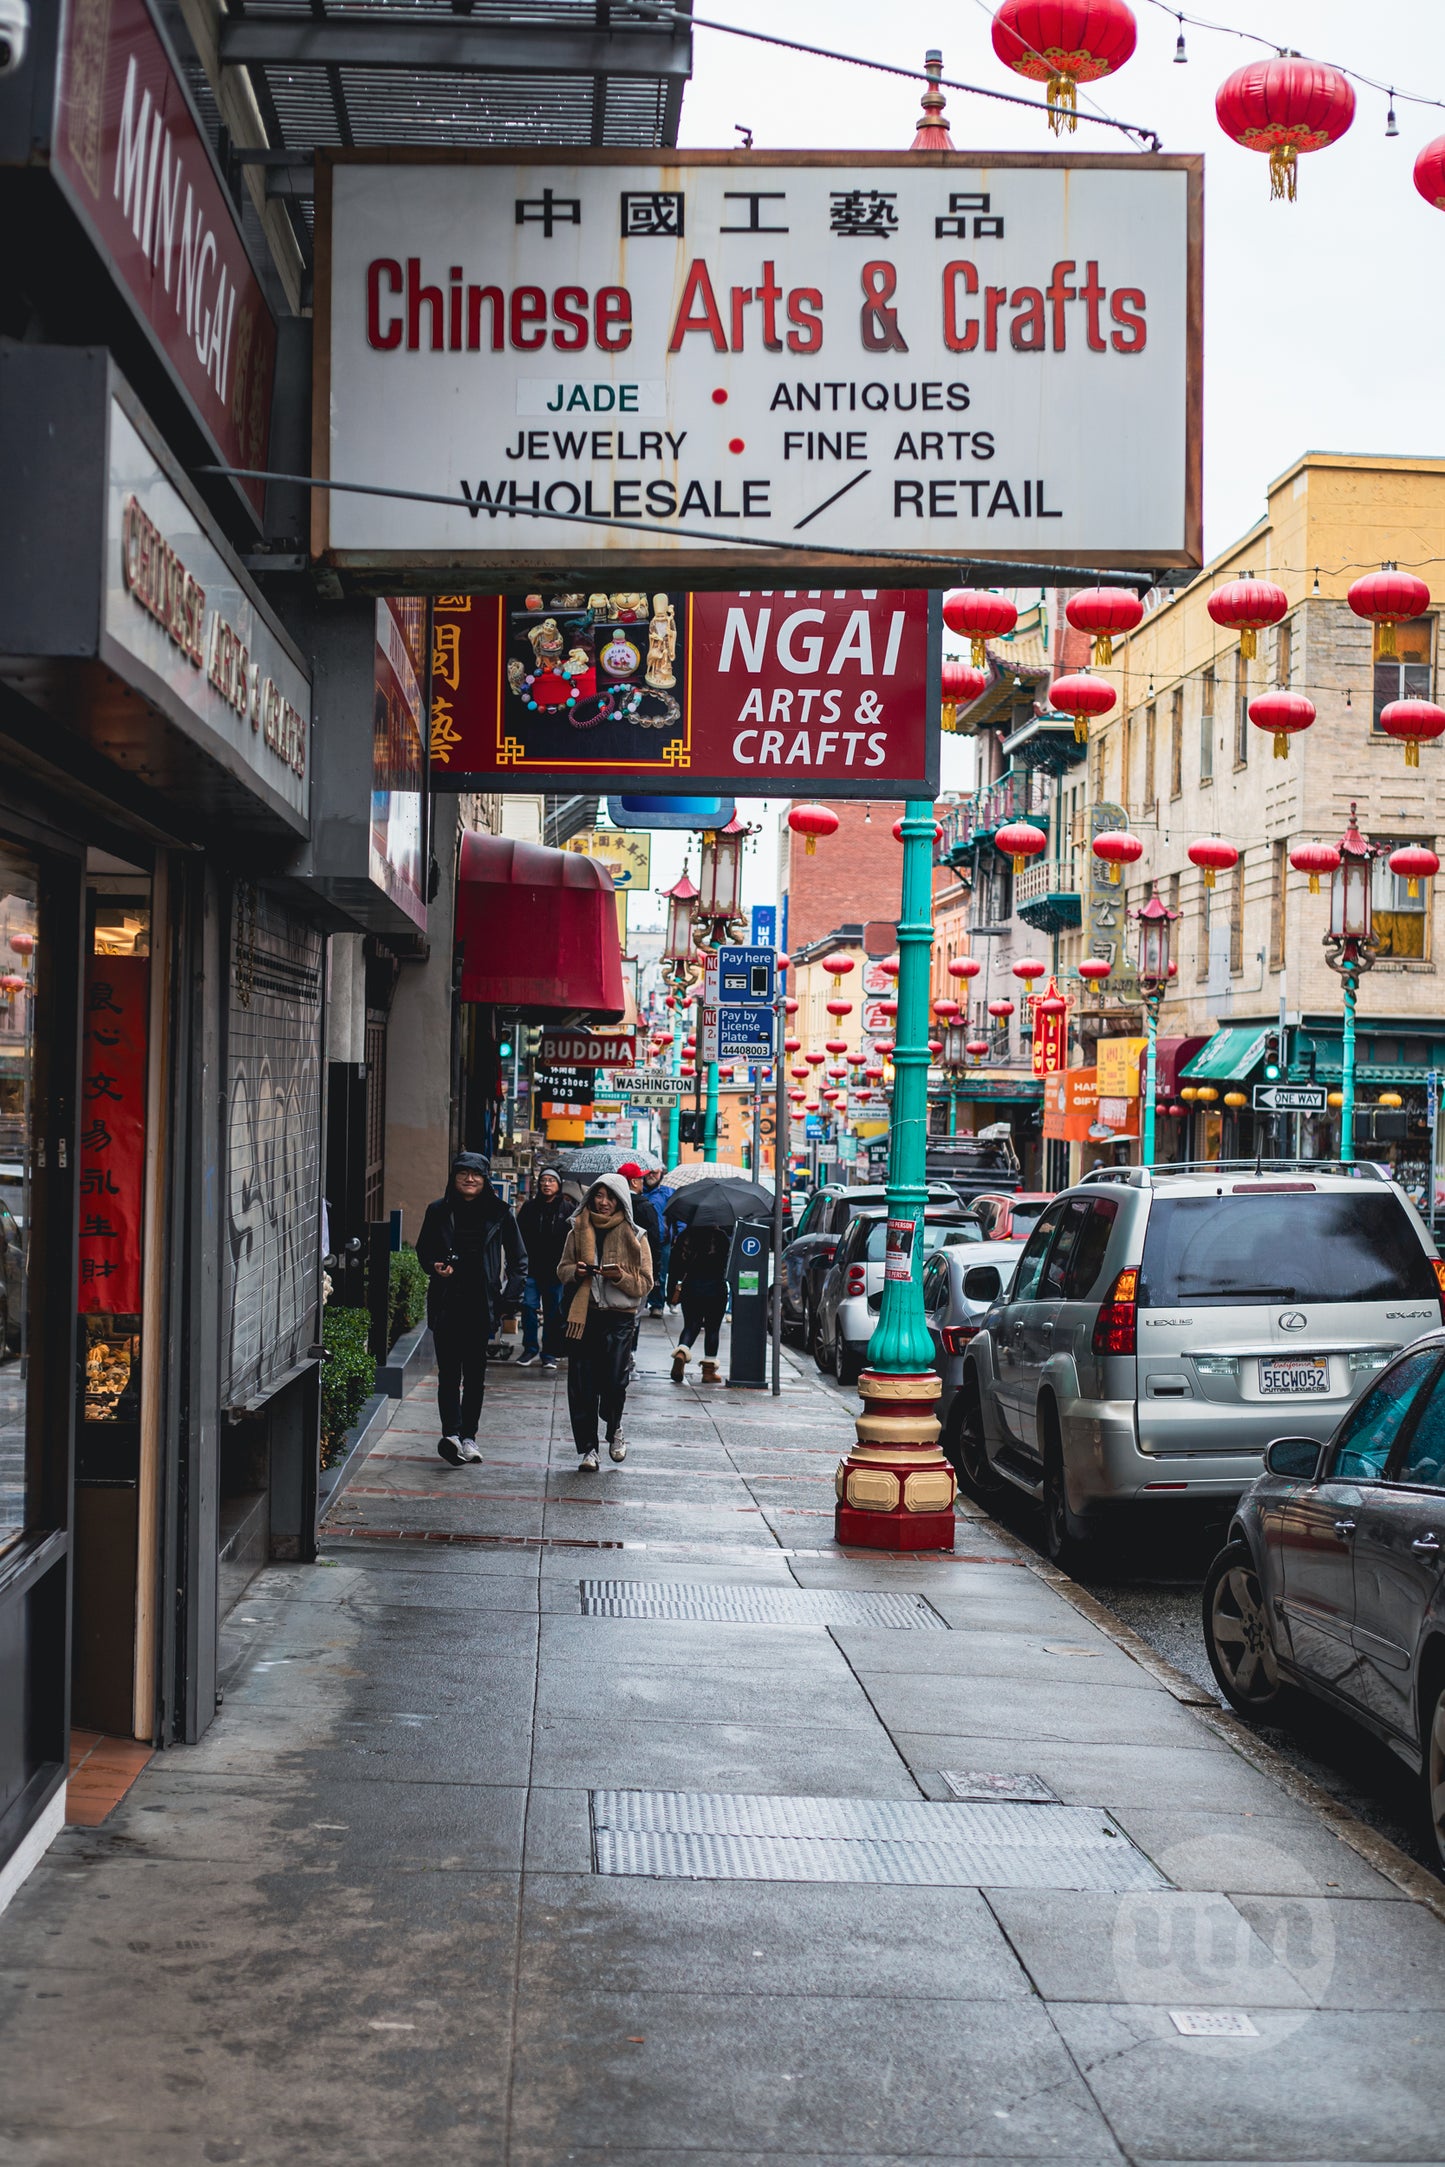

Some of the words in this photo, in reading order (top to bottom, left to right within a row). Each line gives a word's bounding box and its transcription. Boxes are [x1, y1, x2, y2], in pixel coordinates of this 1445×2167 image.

[515, 188, 1005, 239] 中國工藝品
[113, 54, 183, 293] MIN
[176, 182, 236, 406] NGAI
[366, 257, 633, 353] Chinese
[668, 258, 824, 353] Arts
[860, 259, 909, 354] &
[942, 258, 1147, 353] Crafts
[547, 384, 639, 413] JADE
[770, 381, 971, 412] ANTIQUES
[506, 430, 687, 460] JEWELRY
[784, 431, 868, 461] FINE
[894, 430, 995, 460] ARTS
[461, 479, 772, 519] WHOLESALE
[893, 479, 1062, 518] RETAIL
[122, 494, 206, 669] CHINESE
[207, 609, 248, 719] ARTS
[718, 607, 906, 676] NGAI
[738, 689, 843, 724] ARTS
[853, 689, 885, 724] &
[731, 730, 888, 767] CRAFTS
[722, 952, 743, 965] Pay
[745, 952, 771, 963] here
[721, 1011, 741, 1023] Pay
[744, 1011, 757, 1023] by
[721, 1021, 760, 1031] License
[721, 1032, 748, 1041] Plate
[544, 1040, 633, 1060] BUDDHA
[722, 1046, 768, 1055] 44408003
[562, 1077, 589, 1087] shoes
[616, 1078, 692, 1091] WASHINGTON
[552, 1089, 573, 1097] 903
[1275, 1094, 1295, 1104] ONE
[1298, 1095, 1320, 1105] WAY
[1073, 1097, 1099, 1106] GIFT
[1146, 1318, 1194, 1327] LEXUS
[1273, 1361, 1313, 1370] California
[1264, 1370, 1325, 1387] 5ECW052
